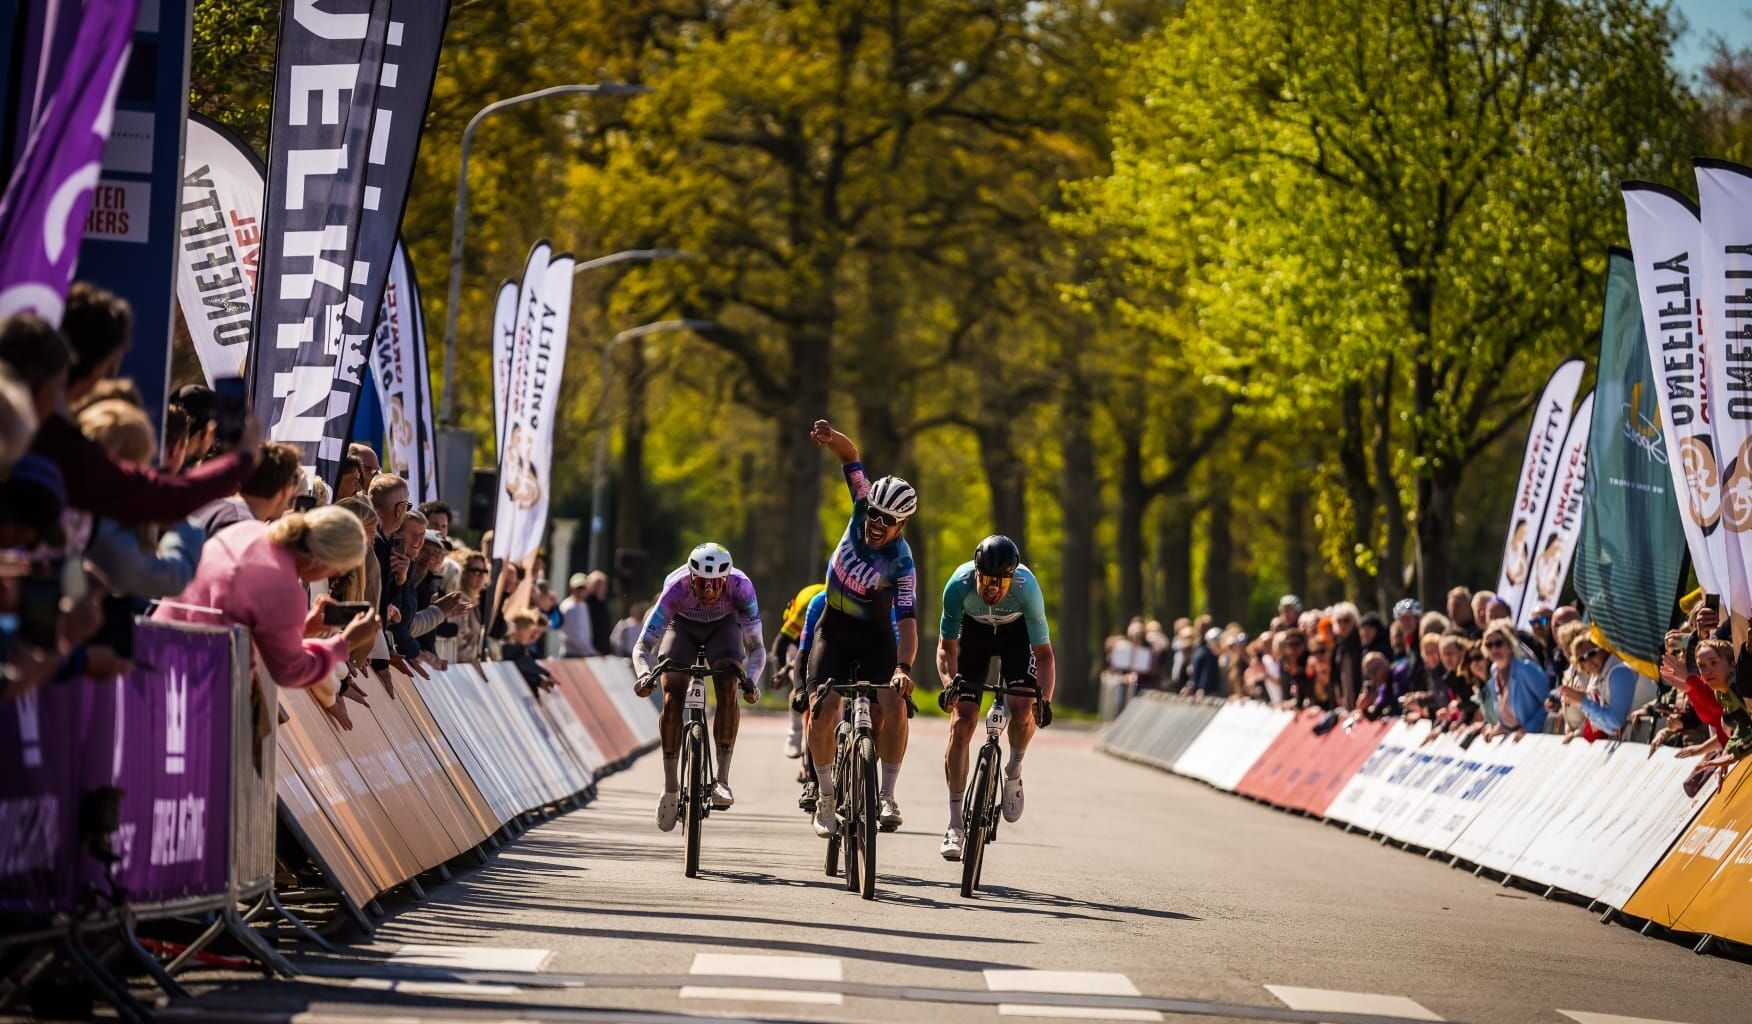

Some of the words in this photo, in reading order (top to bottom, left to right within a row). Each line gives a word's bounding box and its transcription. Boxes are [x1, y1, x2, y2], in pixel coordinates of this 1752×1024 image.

[1552, 443, 1583, 526] GRAVEL
[839, 541, 881, 590] ATAIA
[896, 575, 913, 607] BATAIA
[688, 688, 701, 698] 78
[992, 714, 1003, 723] 81
